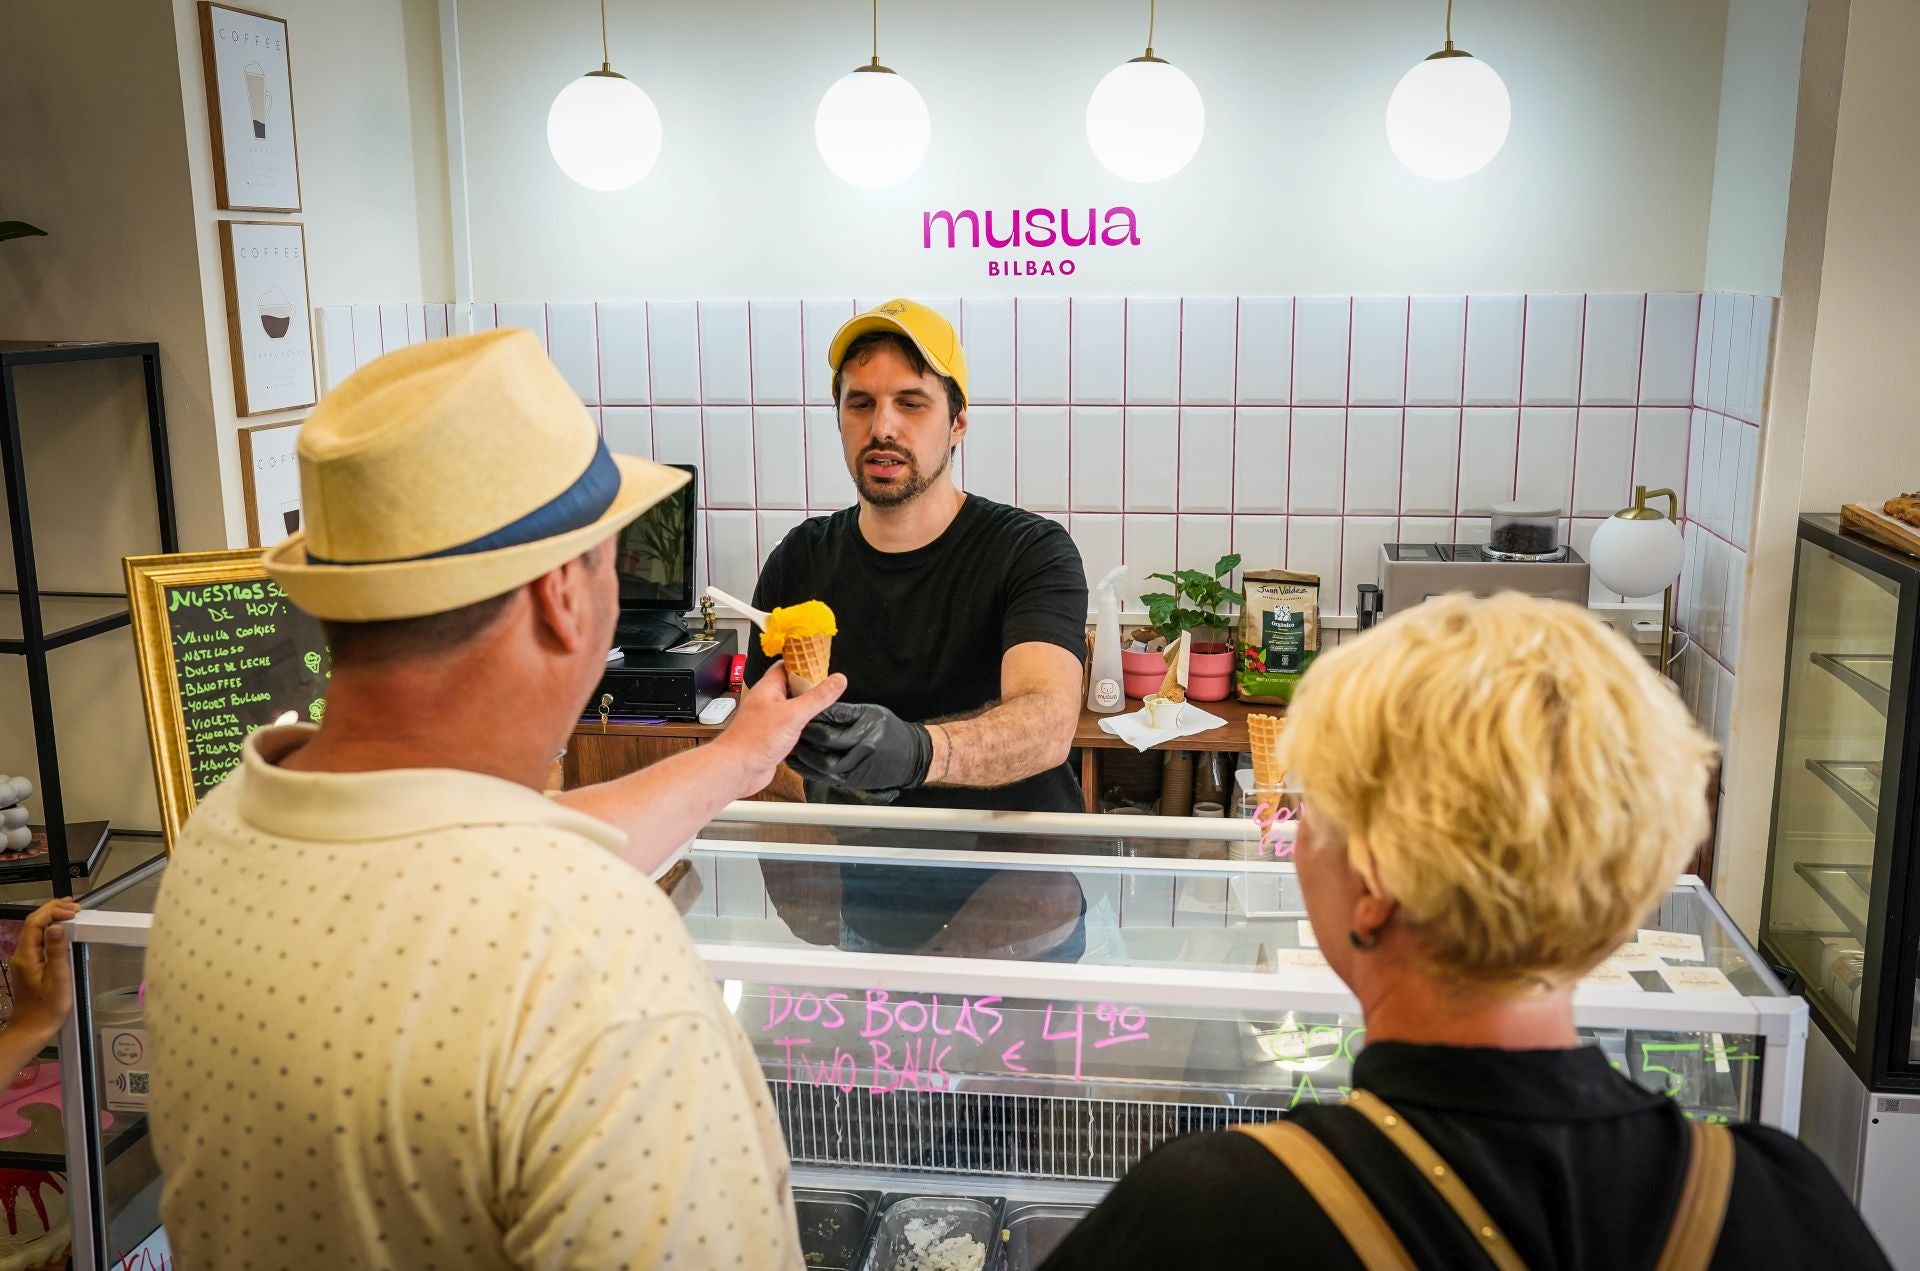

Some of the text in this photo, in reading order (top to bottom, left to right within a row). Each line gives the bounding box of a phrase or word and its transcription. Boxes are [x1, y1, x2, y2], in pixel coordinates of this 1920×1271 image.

[219, 28, 281, 51] COFFEE
[923, 206, 1141, 249] musua
[240, 247, 300, 259] COFFEE
[988, 259, 1076, 277] BILBAO
[257, 452, 297, 470] COFF
[168, 583, 265, 612] NUESTROS
[1256, 585, 1308, 596] Juan Valdez
[207, 607, 235, 622] DE
[184, 664, 220, 678] DULCE
[240, 656, 271, 670] LECHE
[185, 677, 242, 697] BANOFFEE
[187, 697, 226, 713] YOGURT
[191, 713, 240, 731] VIOLETA
[196, 741, 244, 756] FRAMBU
[199, 757, 241, 772] MANGO
[203, 770, 232, 786] COC
[762, 984, 1003, 1046] DOS BOLAS
[774, 1035, 856, 1094] TWO
